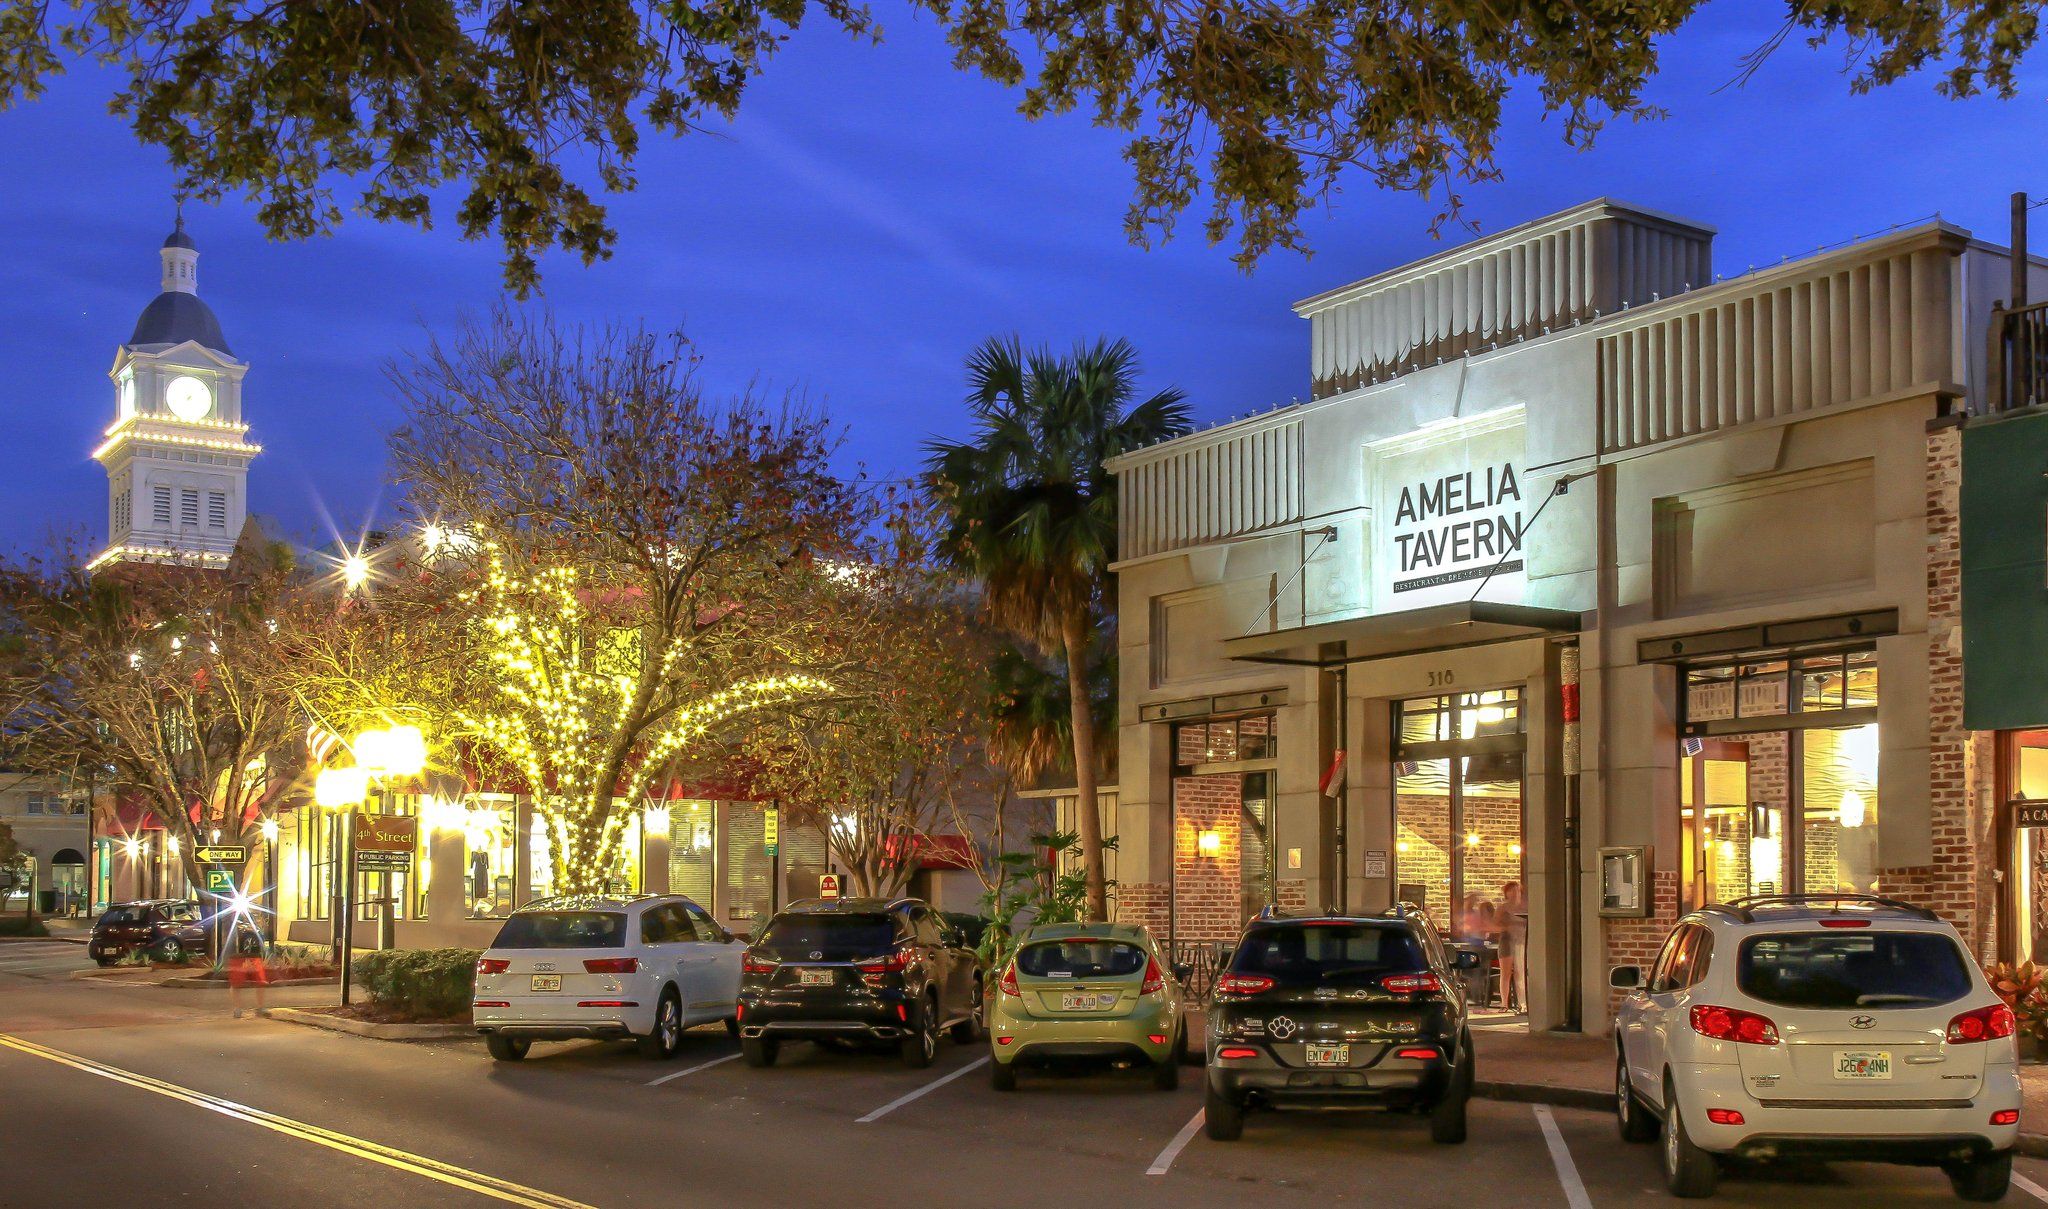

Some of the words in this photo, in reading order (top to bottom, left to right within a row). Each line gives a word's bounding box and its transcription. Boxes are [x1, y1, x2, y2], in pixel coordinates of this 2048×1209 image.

[1395, 462, 1520, 526] AMELIA
[1395, 512, 1522, 571] TAVERN
[2022, 811, 2030, 821] A
[356, 829, 371, 841] 4th
[375, 830, 413, 843] Street
[1837, 1059, 1856, 1072] J26
